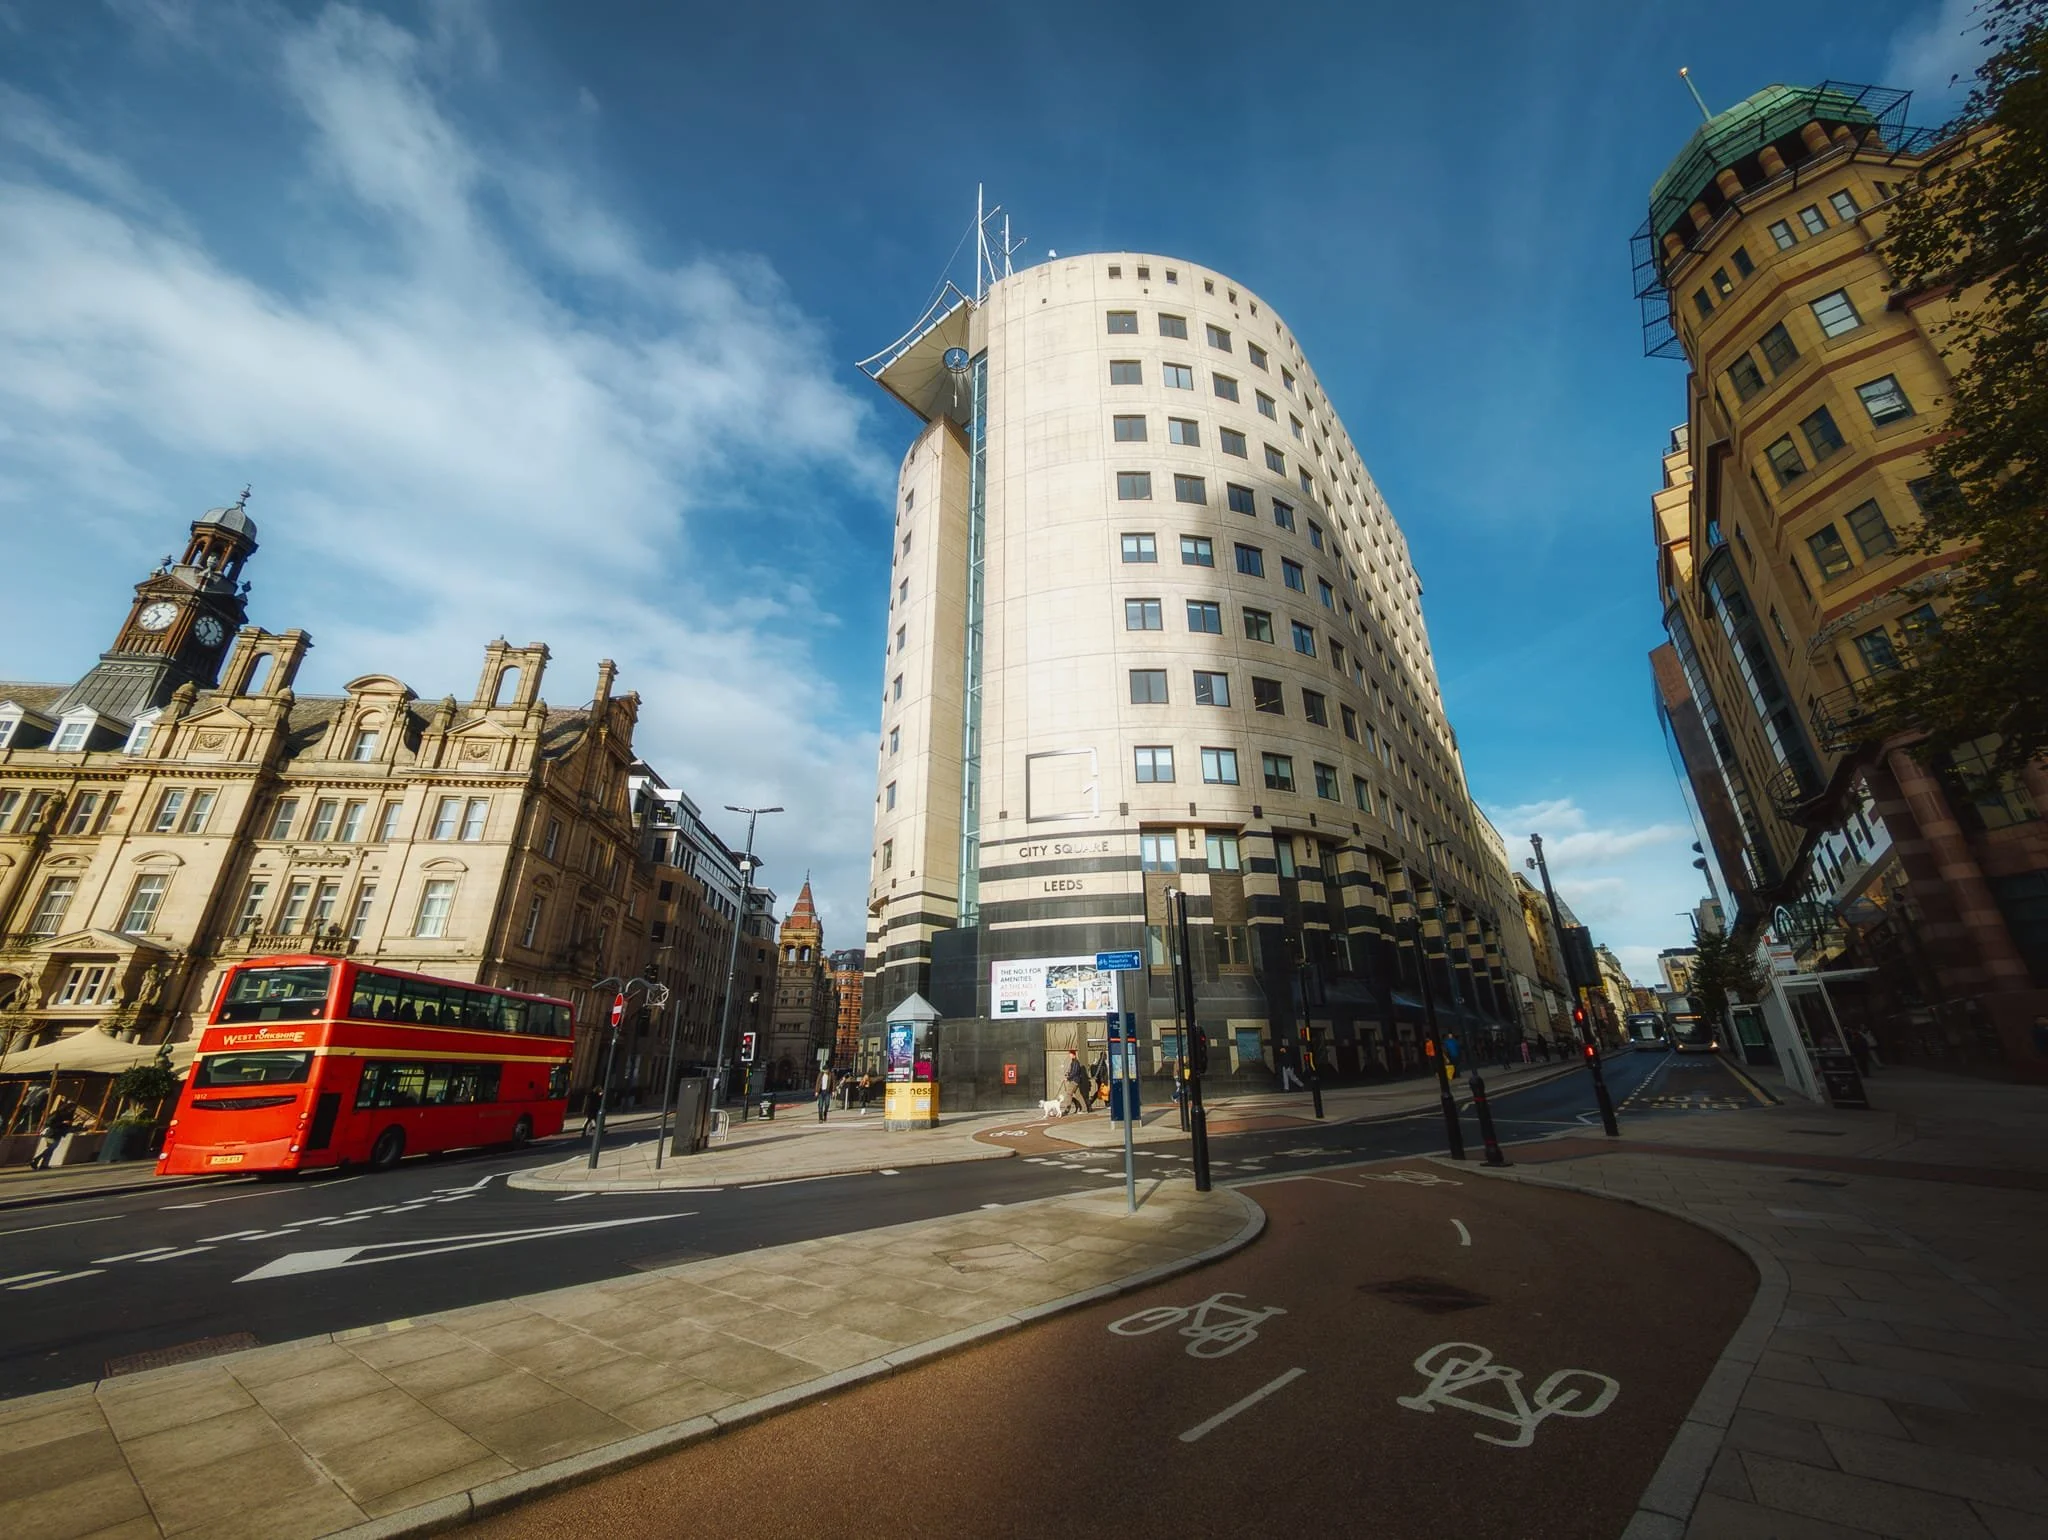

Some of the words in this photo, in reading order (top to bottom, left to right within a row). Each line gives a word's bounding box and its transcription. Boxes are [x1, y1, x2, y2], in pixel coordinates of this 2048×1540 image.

[1019, 845, 1048, 858] CITY
[1044, 879, 1083, 892] LEEDS
[224, 1034, 254, 1045] WEST
[255, 1031, 306, 1043] YORKSHIRE
